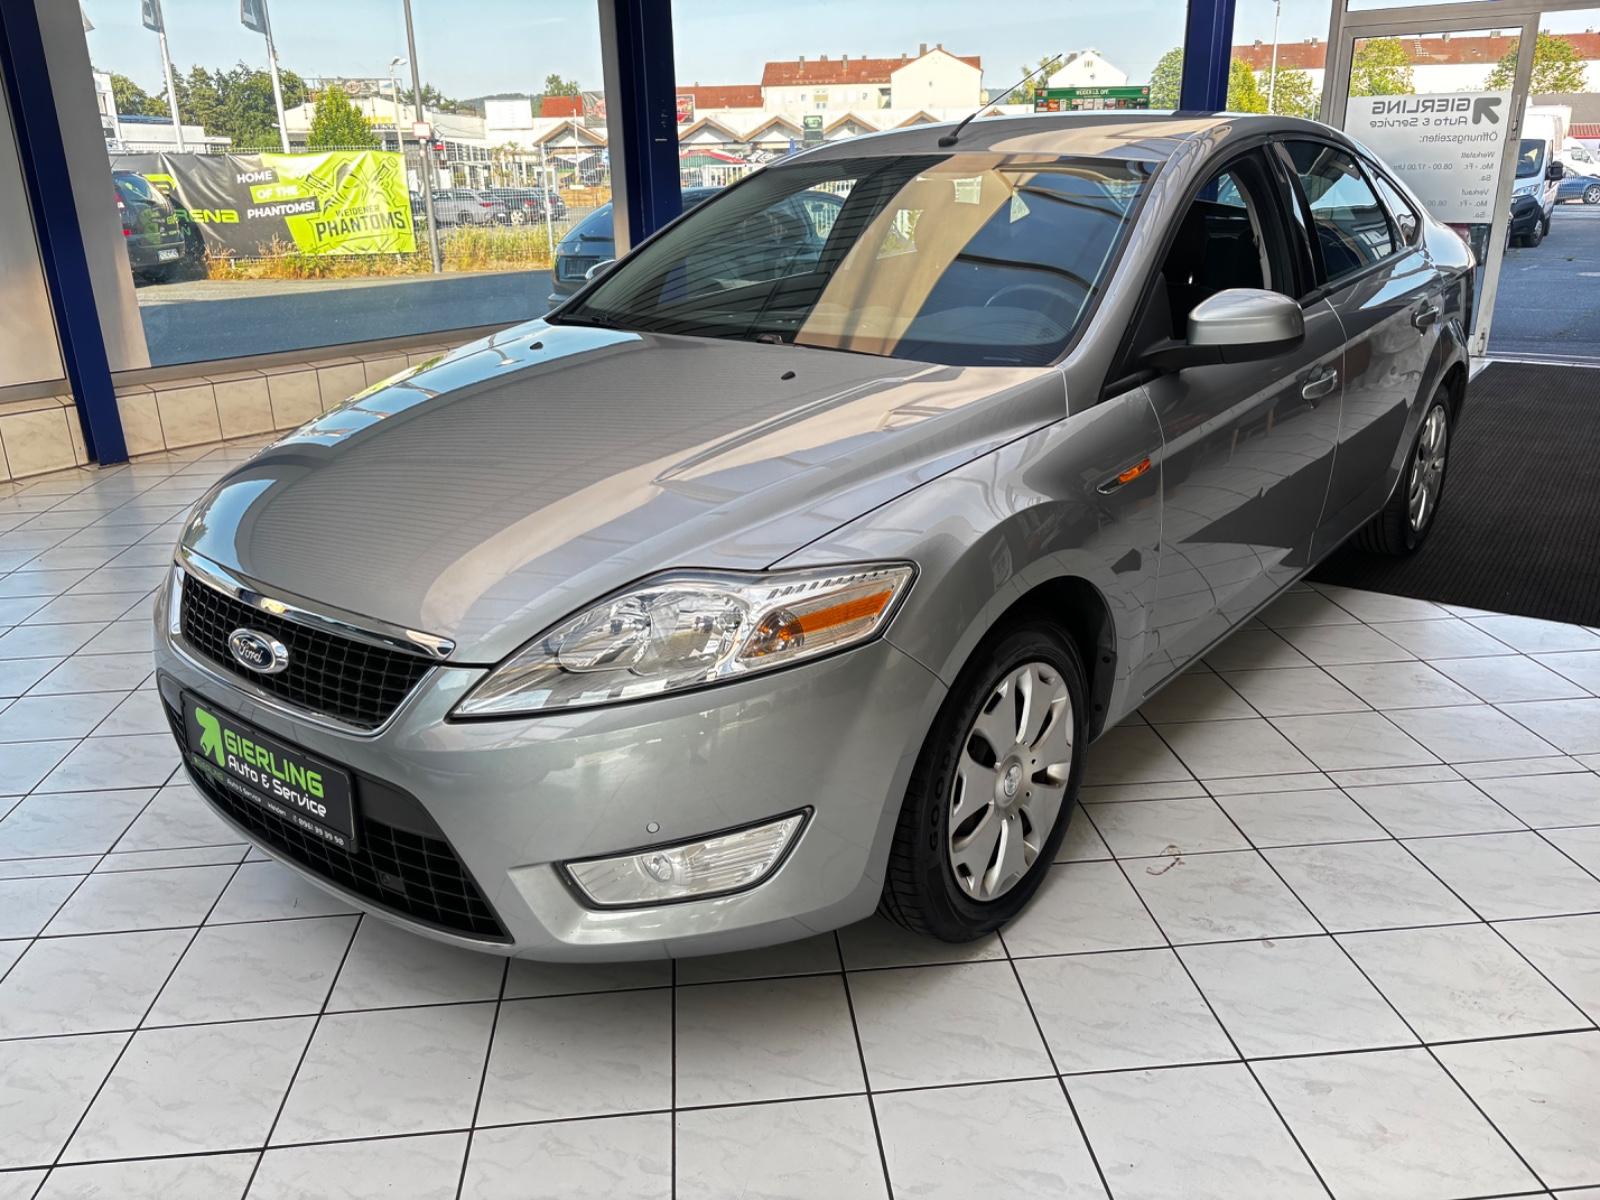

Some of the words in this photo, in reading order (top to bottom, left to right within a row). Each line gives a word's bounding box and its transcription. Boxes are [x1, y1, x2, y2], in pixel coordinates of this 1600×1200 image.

[236, 170, 273, 184] HOME
[256, 189, 272, 199] OF
[276, 186, 298, 197] THE
[247, 201, 315, 219] PHANTOMS!
[335, 204, 380, 217] WEIDENER
[315, 212, 406, 241] PHANTOMS
[239, 638, 263, 664] Ford
[224, 729, 324, 798] GIERLING
[228, 755, 259, 783] Auto
[261, 775, 270, 789] &
[272, 779, 327, 818] Service
